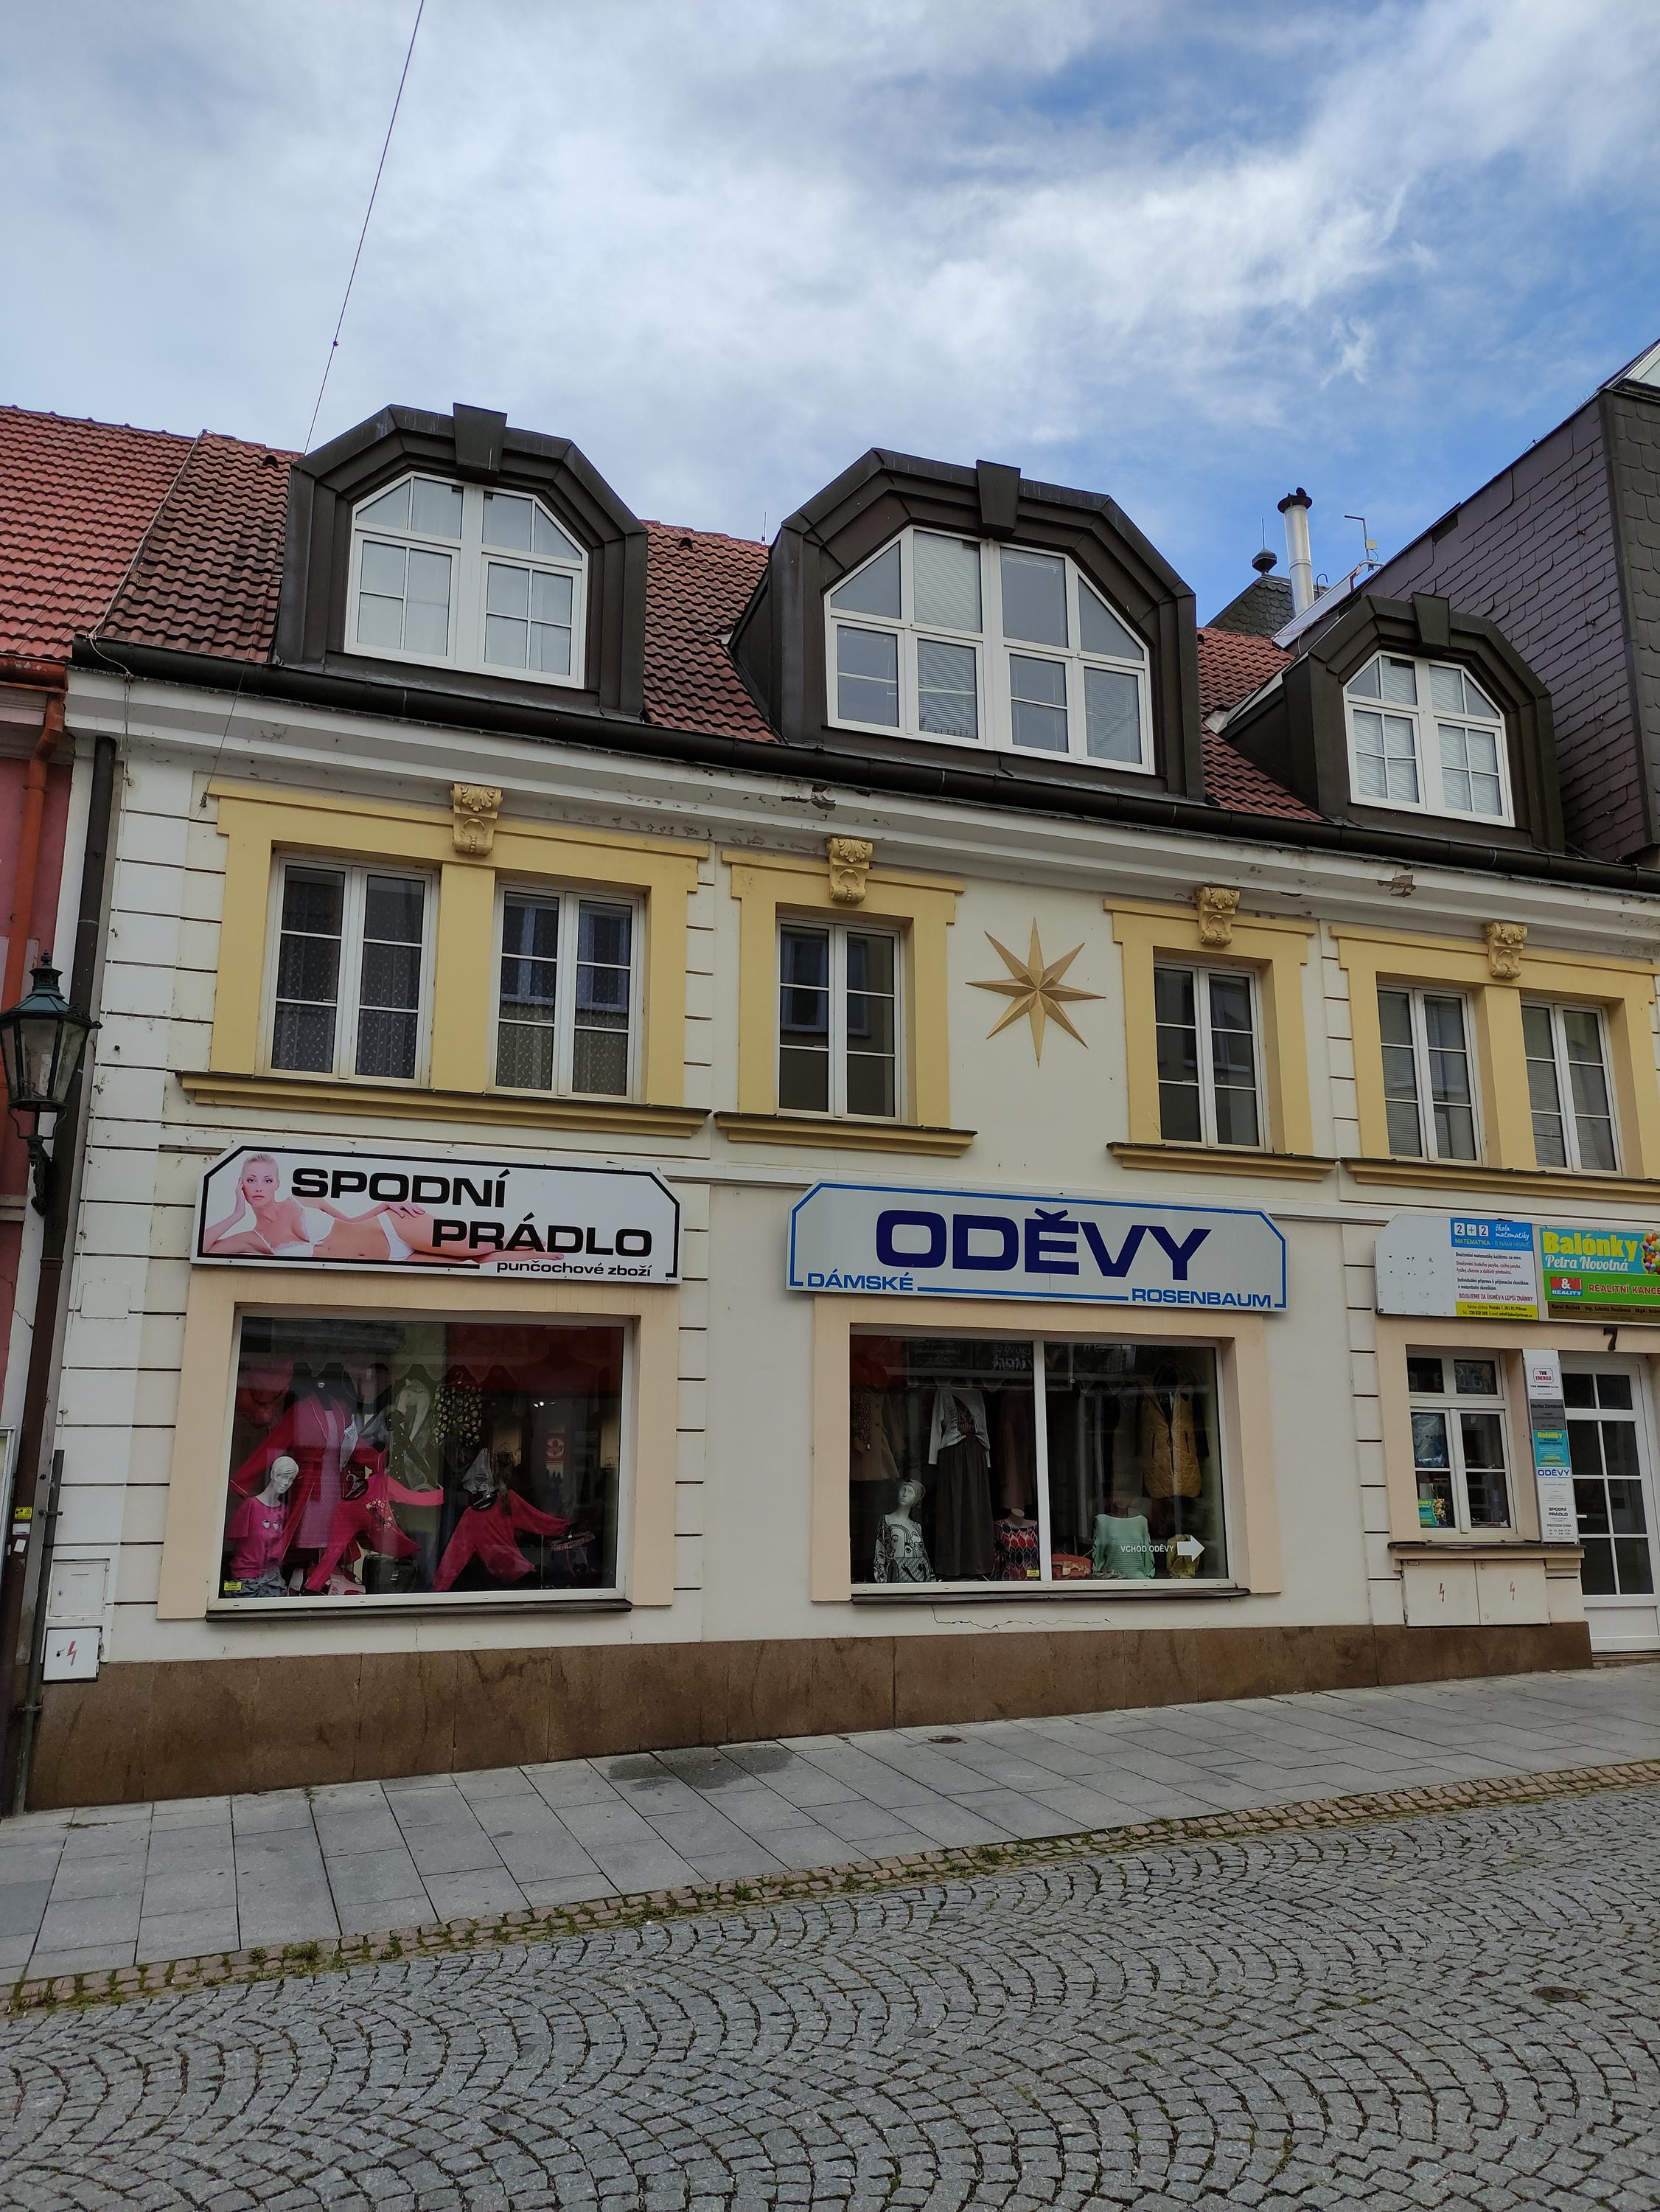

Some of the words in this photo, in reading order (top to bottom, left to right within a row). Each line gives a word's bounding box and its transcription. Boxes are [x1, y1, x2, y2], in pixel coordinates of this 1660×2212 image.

[291, 1167, 511, 1208] SPODNÍ
[431, 1212, 652, 1257] PRÁDLO
[1495, 1223, 1510, 1231] škola
[1495, 1231, 1530, 1241] matematiky
[875, 1207, 1212, 1281] ODĚVY
[1455, 1238, 1490, 1246] MATEMATIKA
[1542, 1231, 1638, 1262] Balónky
[496, 1259, 604, 1277] punčochové
[607, 1263, 652, 1277] zboží
[1545, 1254, 1578, 1269] Petra
[1580, 1256, 1628, 1272] Novotná
[807, 1268, 914, 1292] DÁMSKÉ
[1588, 1284, 1630, 1294] REALITNÍ
[1131, 1288, 1271, 1308] ROSENBAUM
[1603, 1326, 1617, 1351] 7
[1538, 1468, 1569, 1476] ODĚVY
[1120, 1545, 1147, 1553] VCHOD
[1149, 1543, 1174, 1553] ODĚVY
